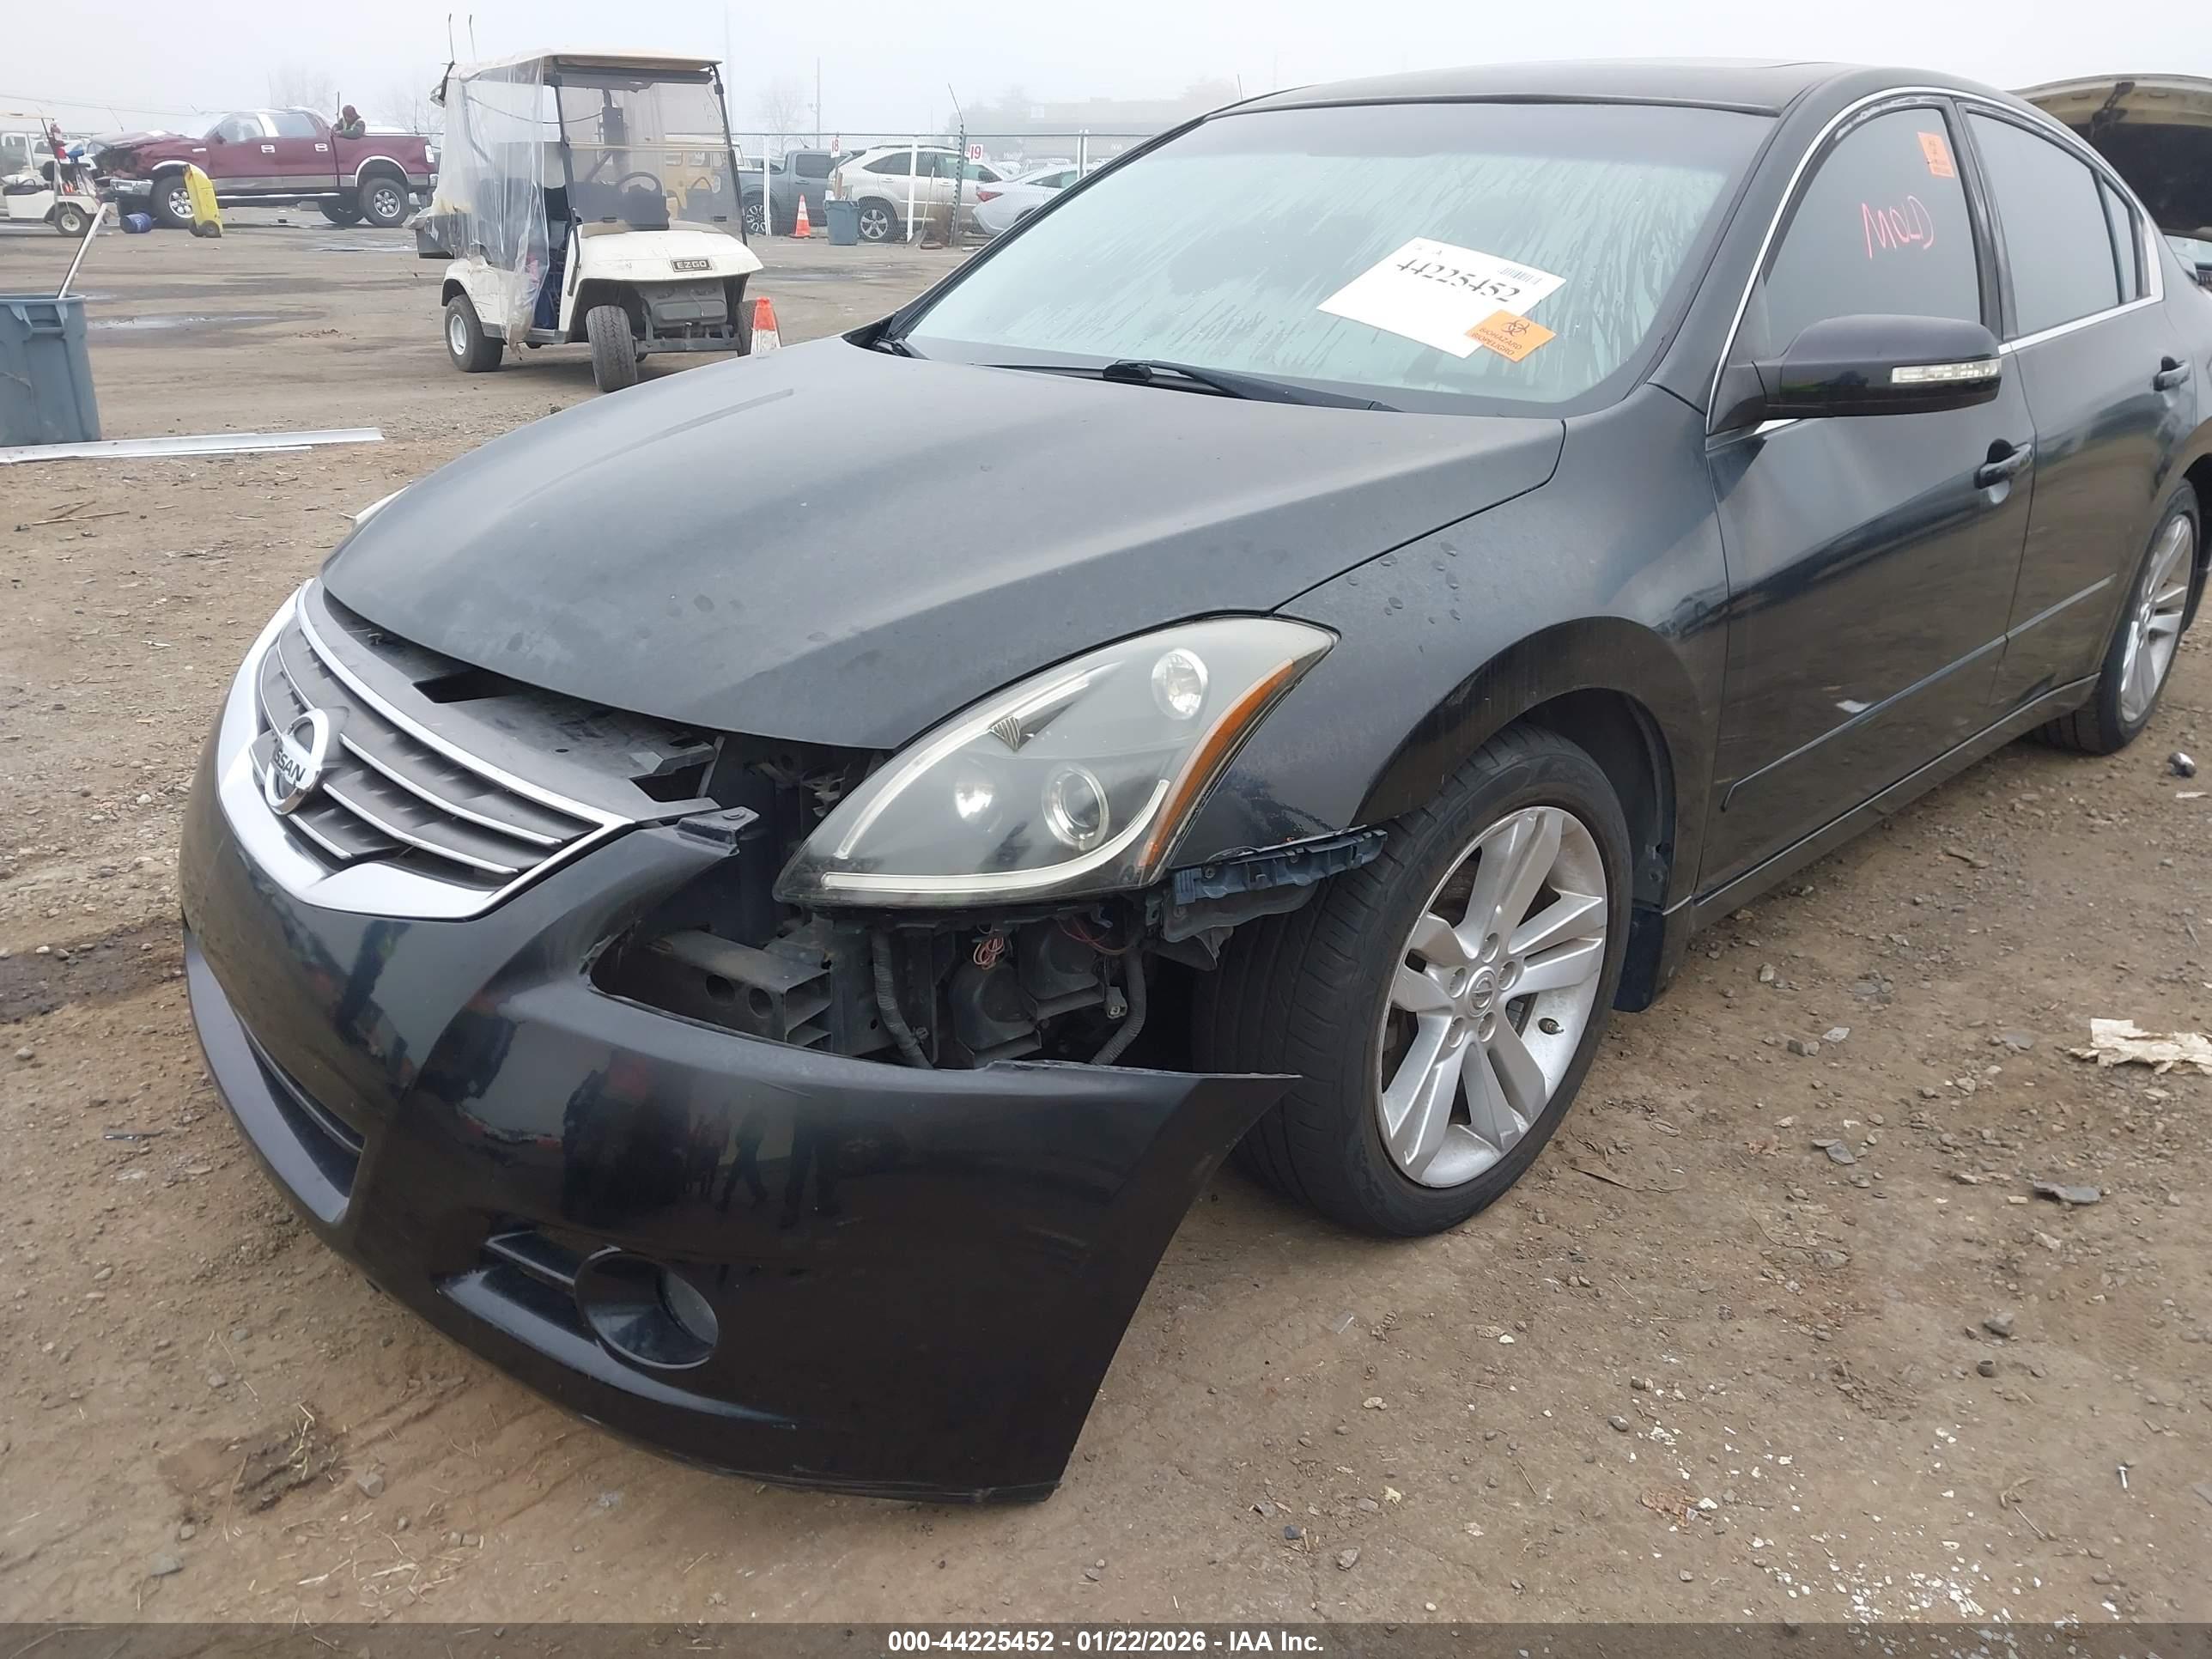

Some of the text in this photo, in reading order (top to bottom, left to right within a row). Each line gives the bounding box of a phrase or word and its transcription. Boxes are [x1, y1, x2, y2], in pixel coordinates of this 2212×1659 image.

[831, 138, 839, 152] 18
[969, 145, 982, 160] 19
[1861, 195, 1935, 260] MOLD
[1396, 258, 1522, 303] 44225452
[1471, 332, 1515, 356] BIOPELIGRO
[1479, 327, 1522, 350] BIOHAZARD
